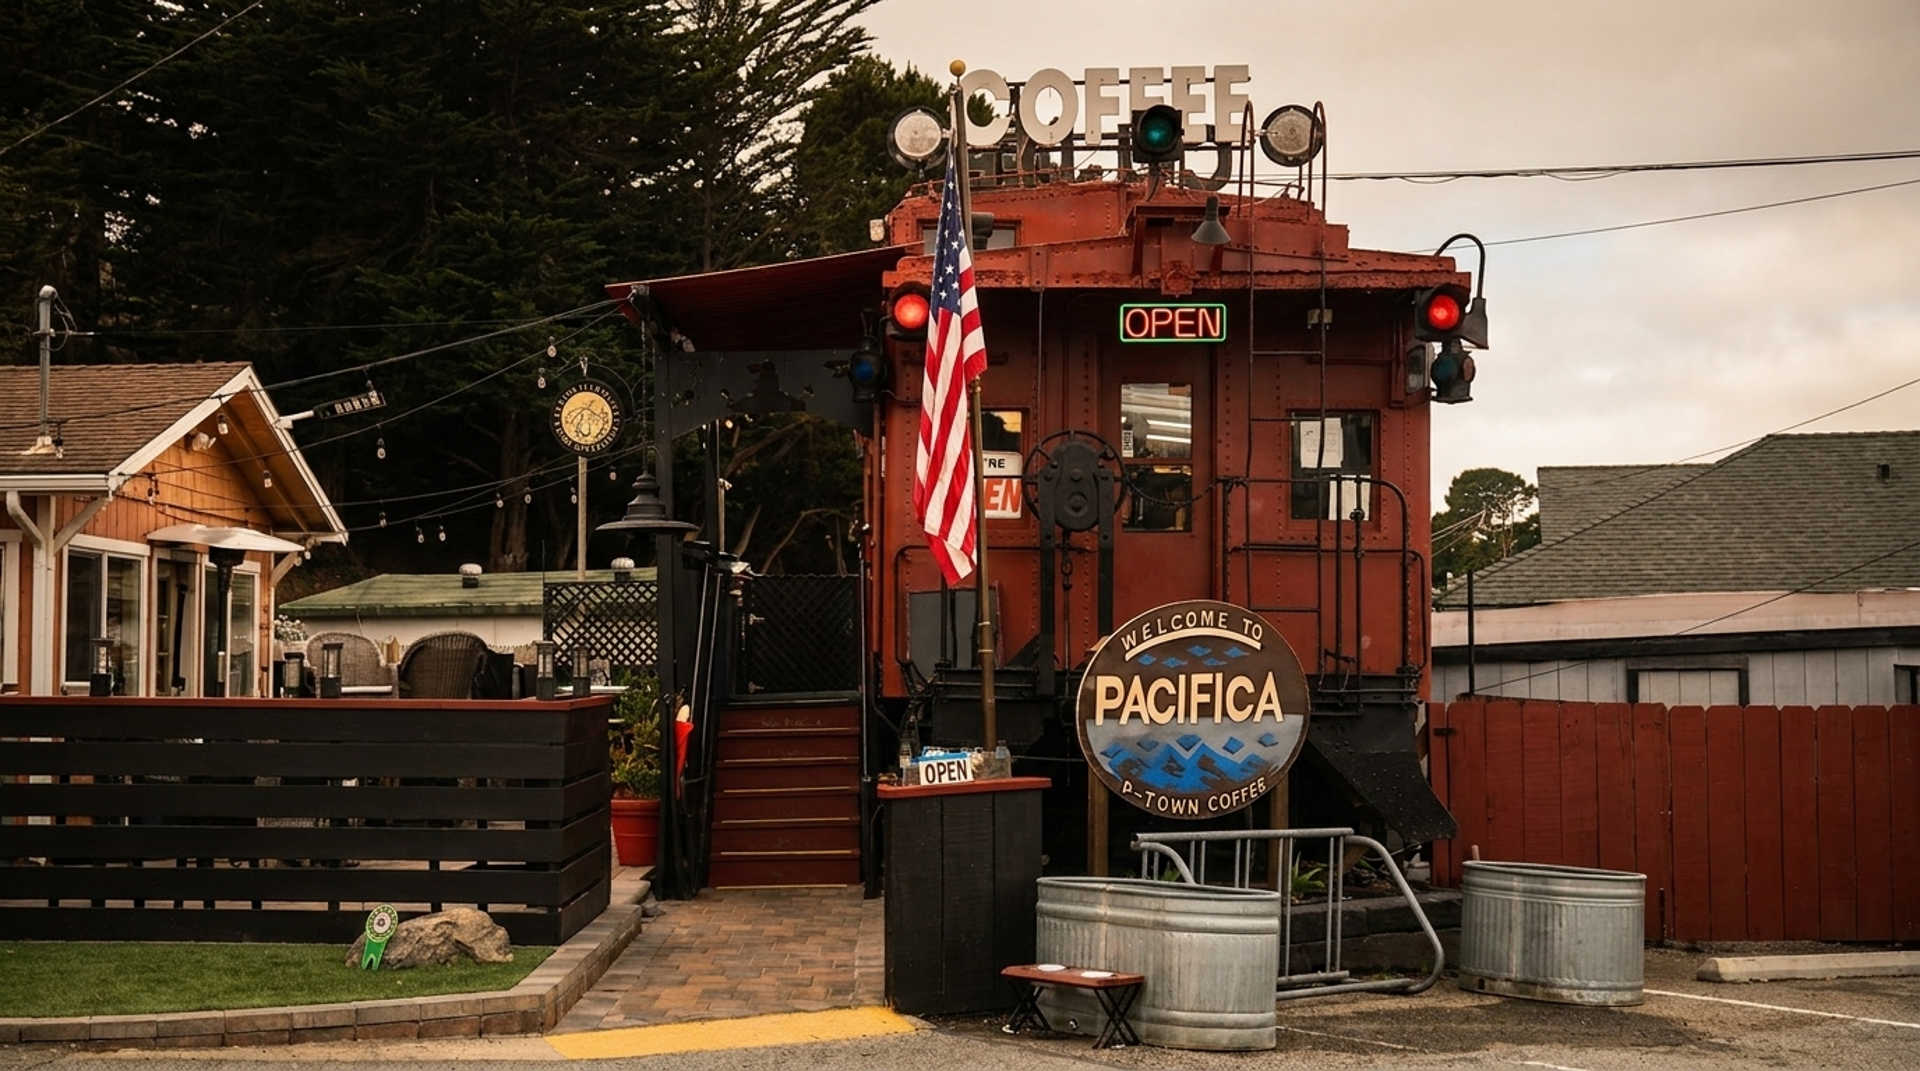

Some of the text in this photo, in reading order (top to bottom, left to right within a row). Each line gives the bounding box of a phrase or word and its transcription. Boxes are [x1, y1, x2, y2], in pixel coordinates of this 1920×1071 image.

[960, 65, 1249, 146] COFFEE
[1125, 307, 1220, 337] OPEN
[985, 478, 1021, 513] EN
[1121, 610, 1264, 651] WELCOME TO
[1095, 671, 1284, 726] PACIFICA
[925, 759, 968, 784] OPEN
